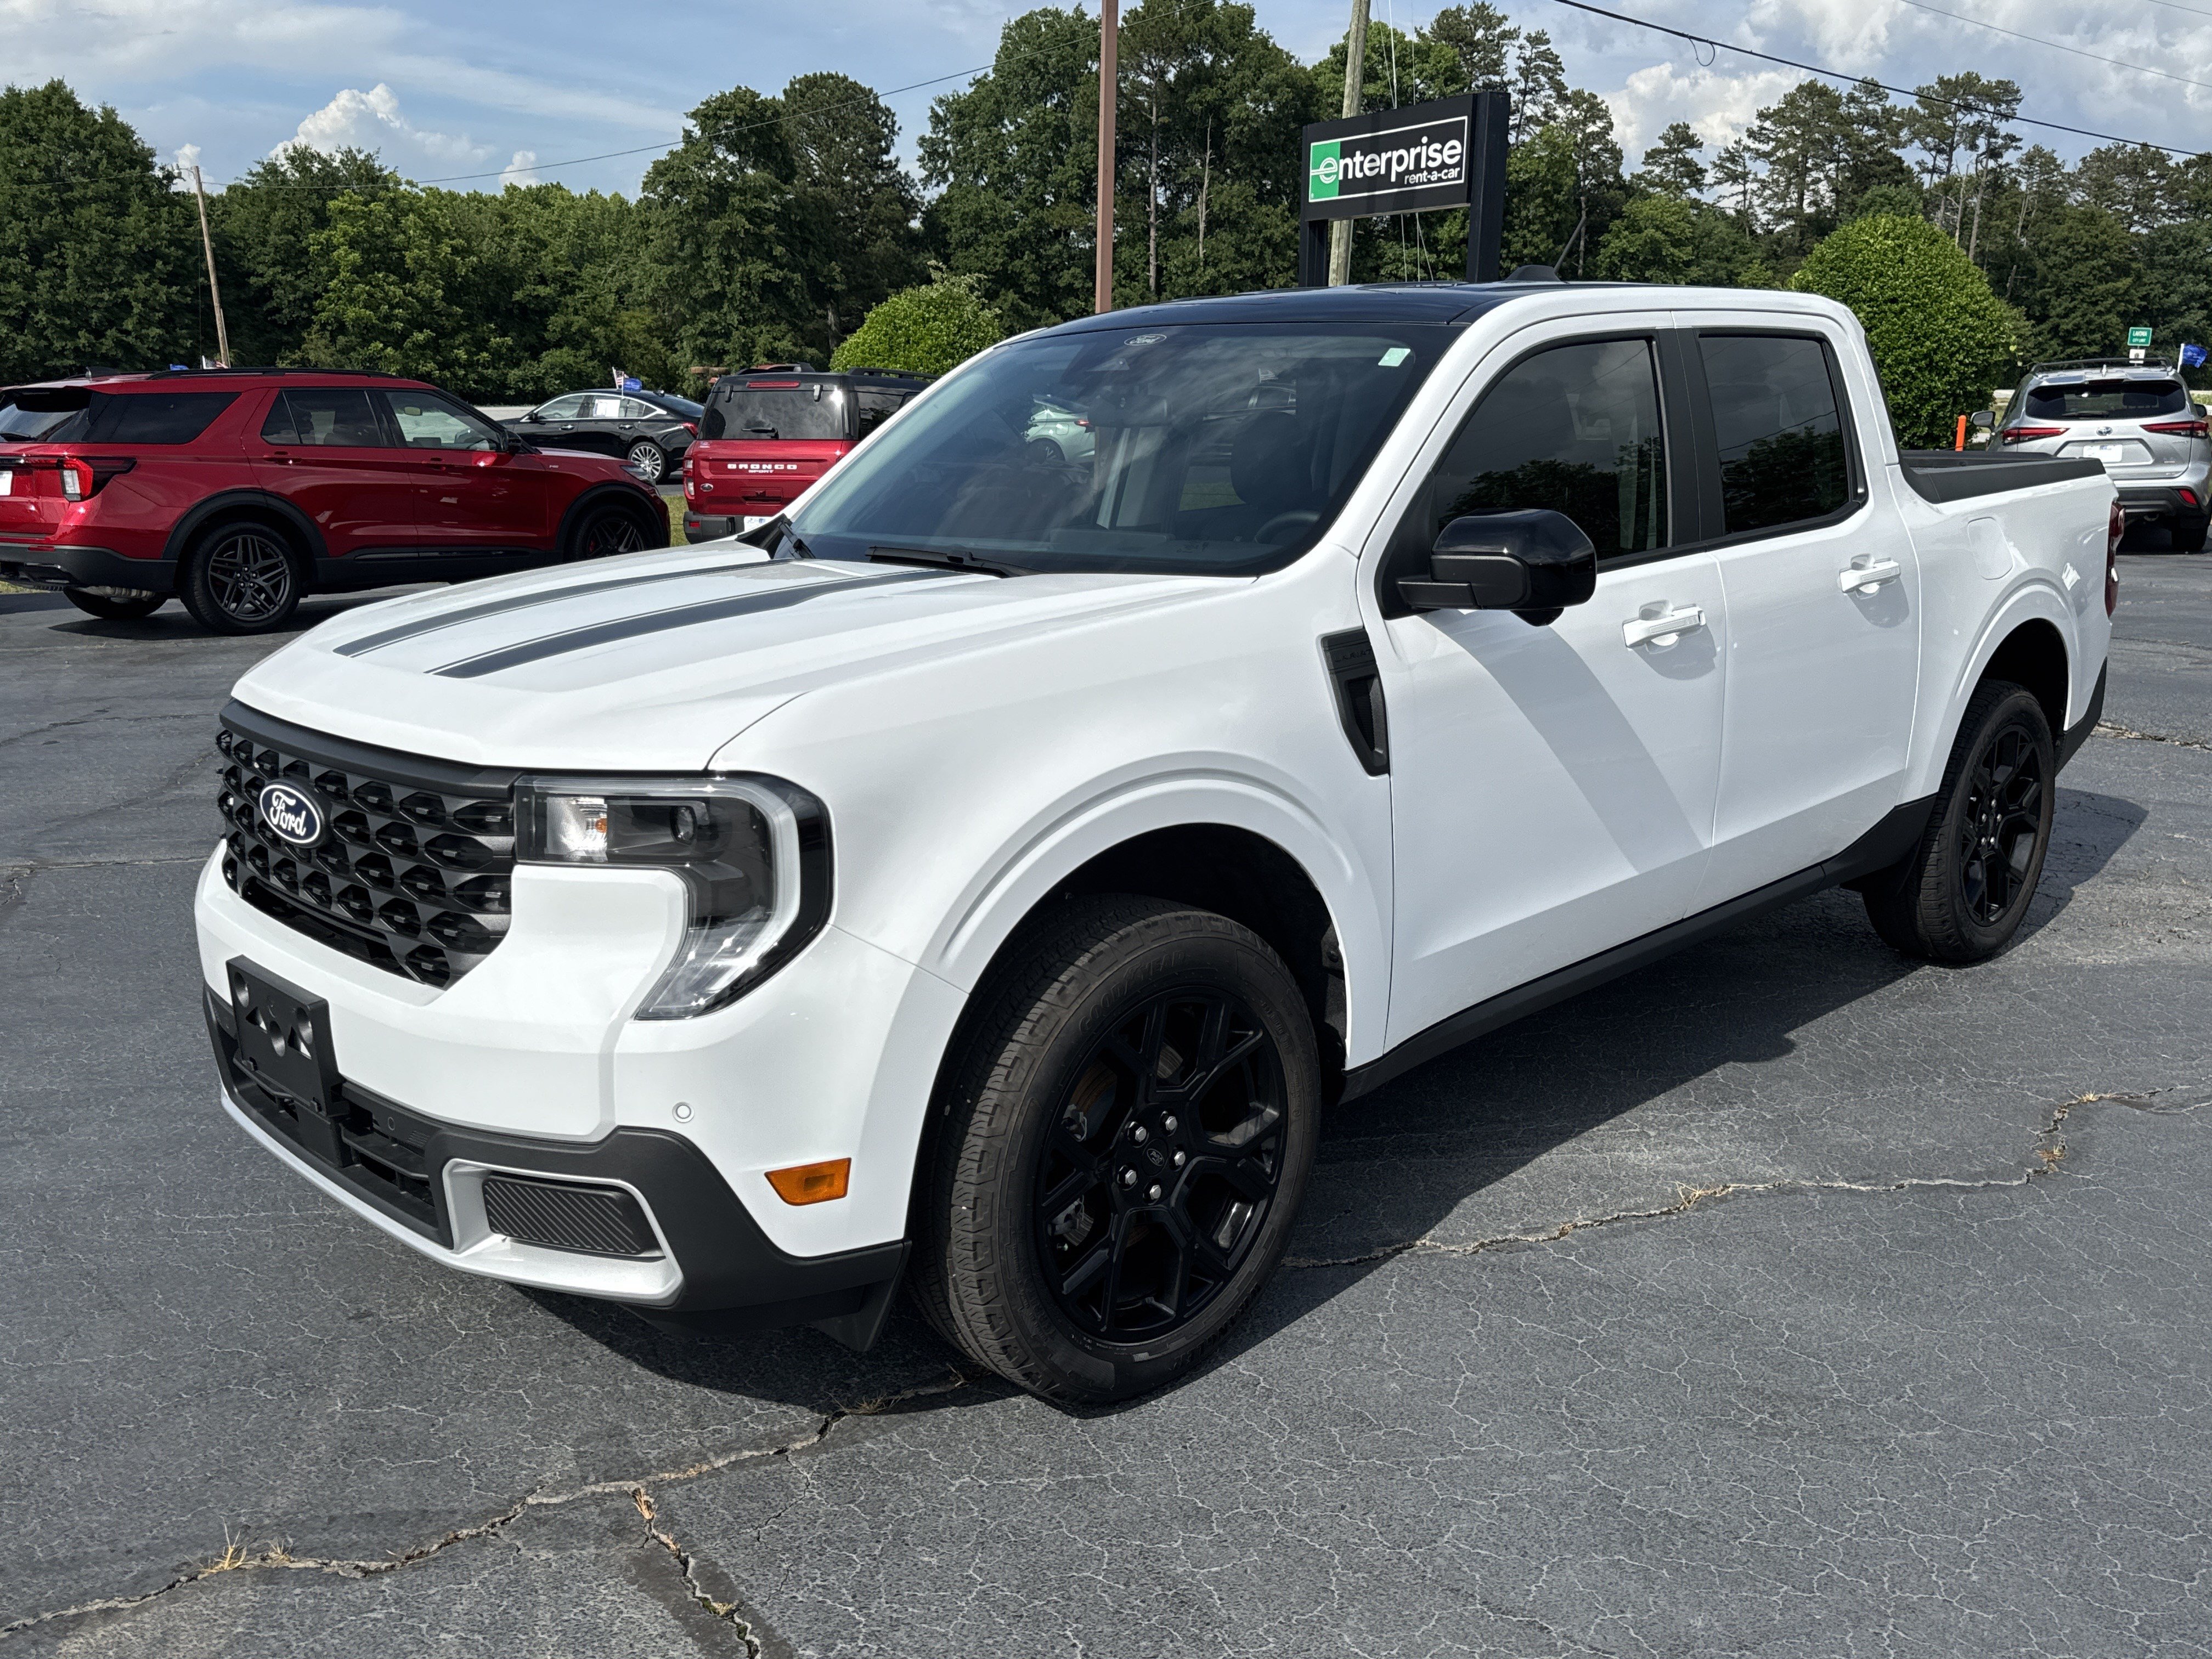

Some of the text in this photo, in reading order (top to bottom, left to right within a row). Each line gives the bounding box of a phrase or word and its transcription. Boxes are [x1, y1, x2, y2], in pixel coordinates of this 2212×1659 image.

[1318, 137, 1462, 184] enterprise
[1404, 166, 1460, 184] rent-a-car
[269, 791, 307, 837] Ford
[1077, 950, 1186, 1035] GOODYEAR
